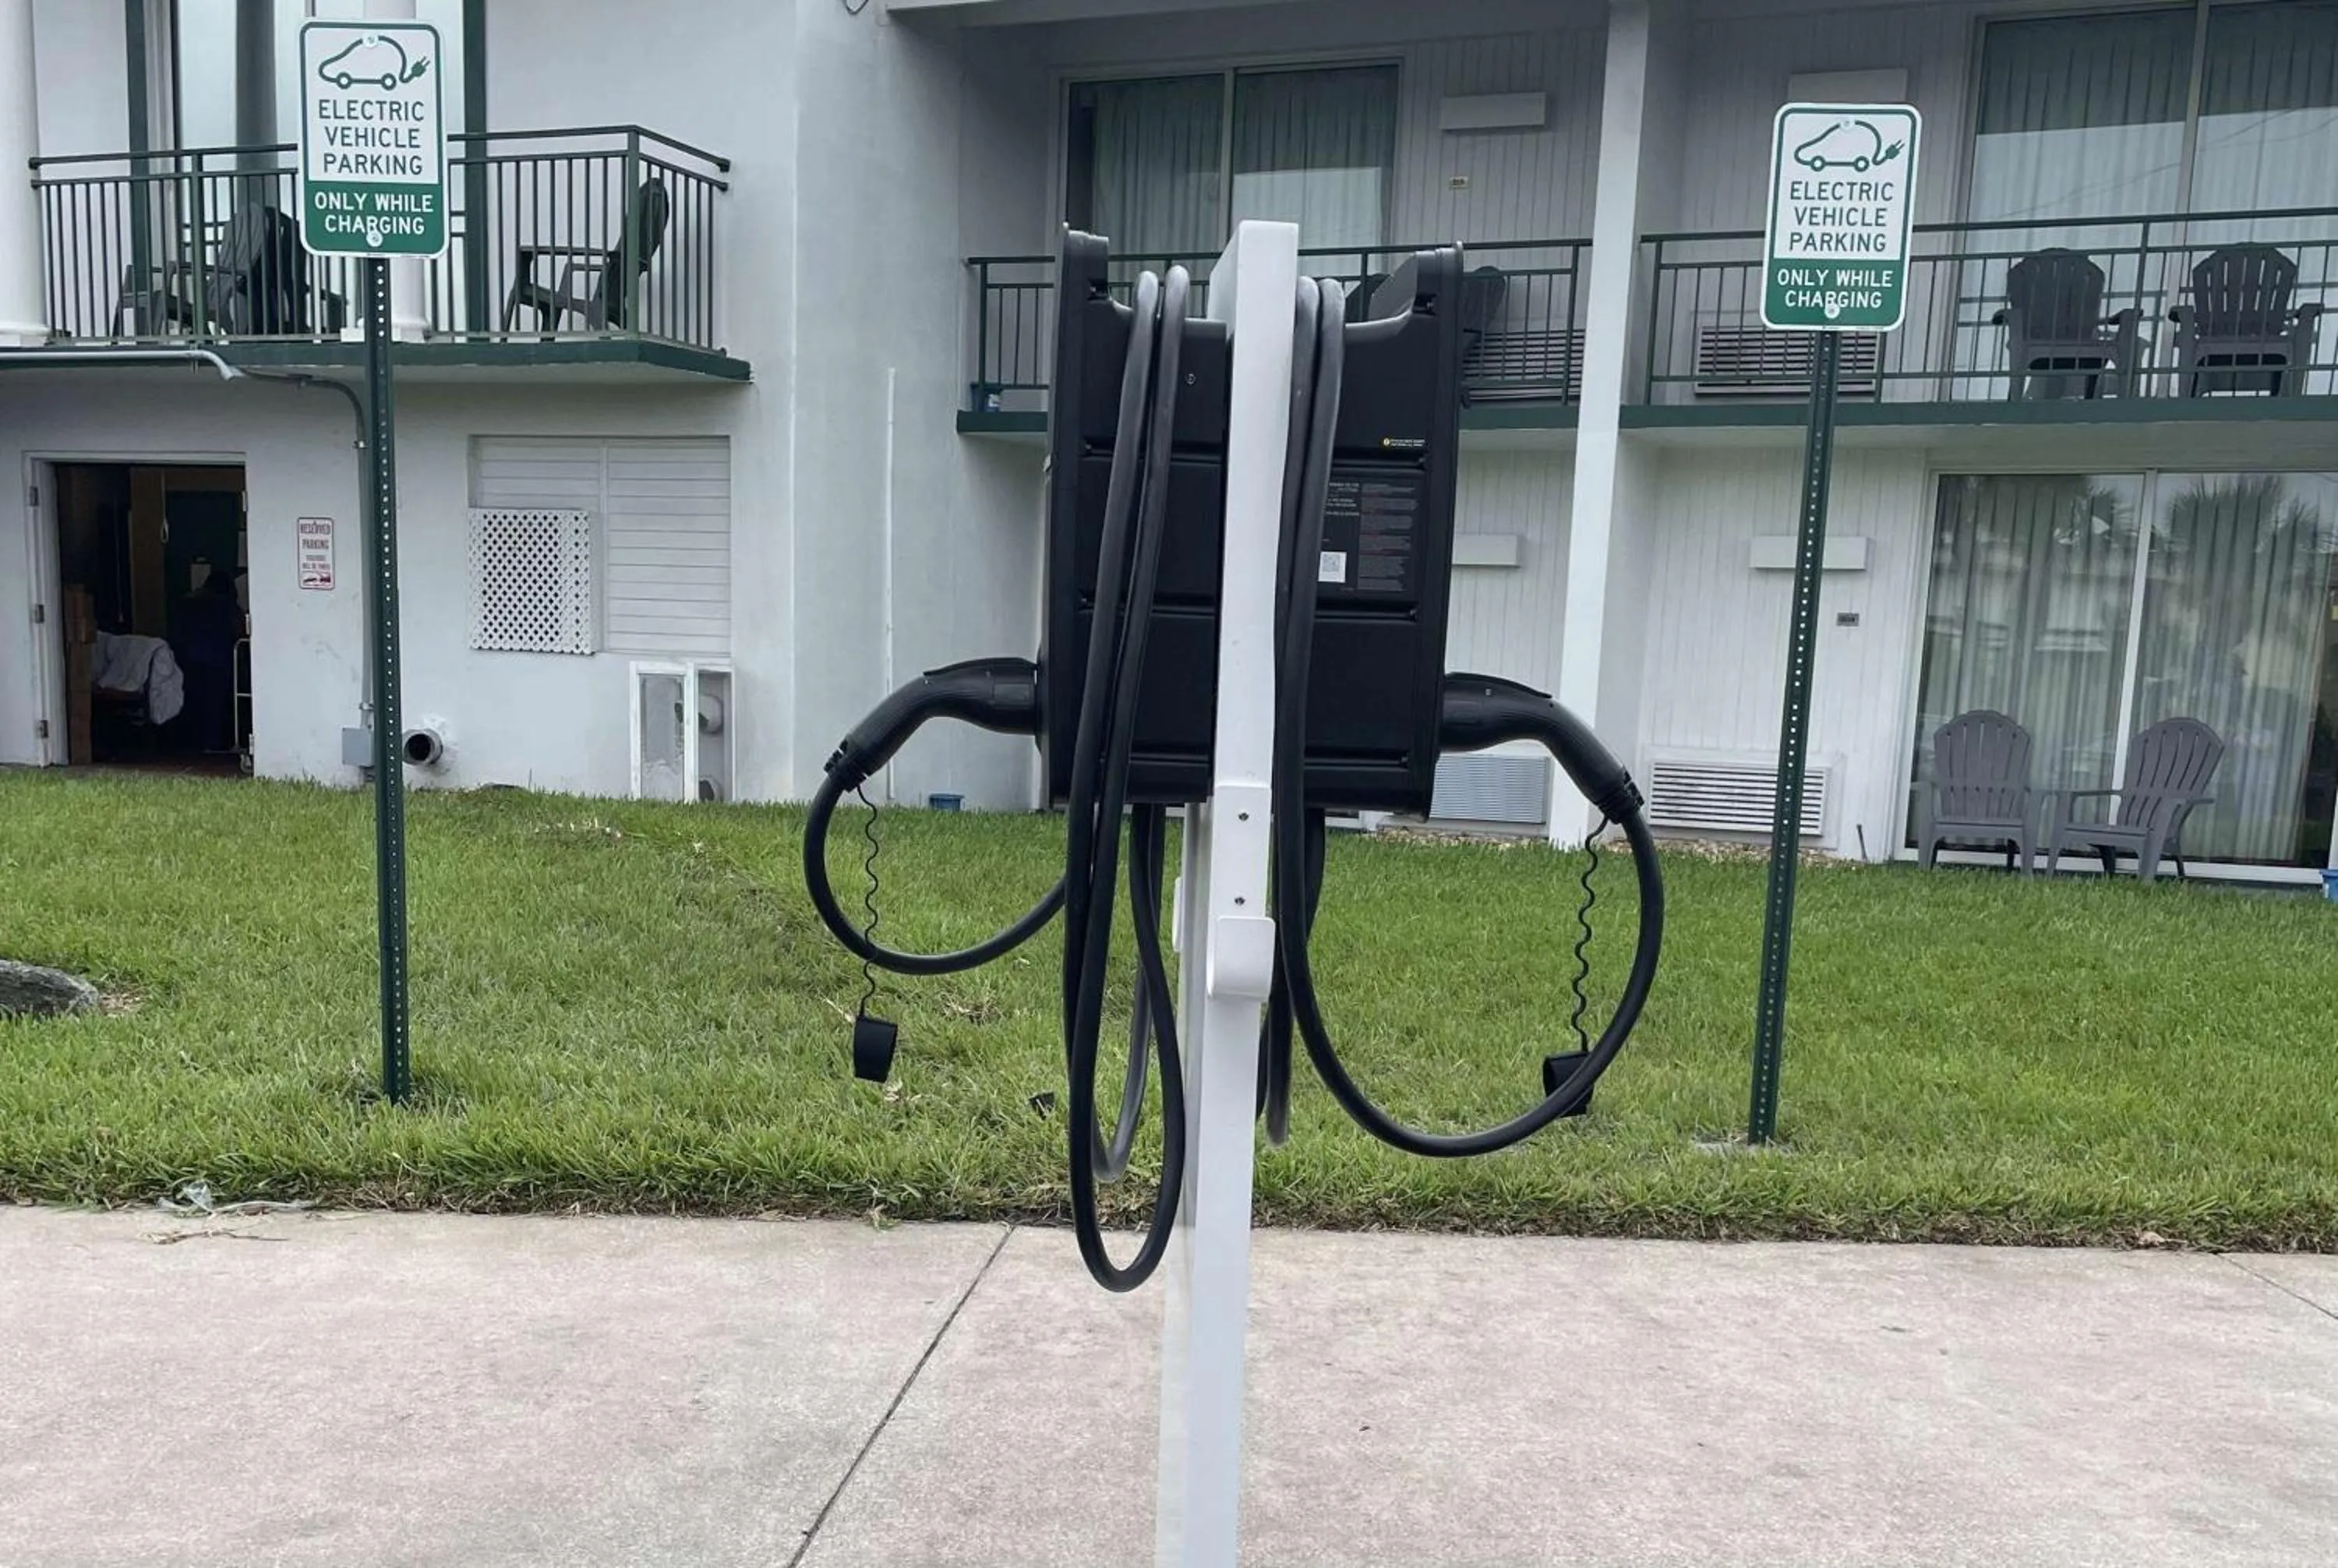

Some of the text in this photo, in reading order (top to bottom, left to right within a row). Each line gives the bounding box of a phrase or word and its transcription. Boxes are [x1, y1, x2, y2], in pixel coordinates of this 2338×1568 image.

[319, 99, 425, 121] ELECTRIC
[324, 126, 421, 148] VEHICLE
[323, 154, 422, 175] PARKING
[315, 192, 434, 212] ONLY WHILE
[1790, 181, 1894, 202] ELECTRIC
[325, 214, 425, 235] CHARGING
[1794, 207, 1888, 227] VEHICLE
[1789, 232, 1887, 253] PARKING
[1777, 269, 1893, 288] ONLY WHILE
[1785, 290, 1882, 309] CHARGING
